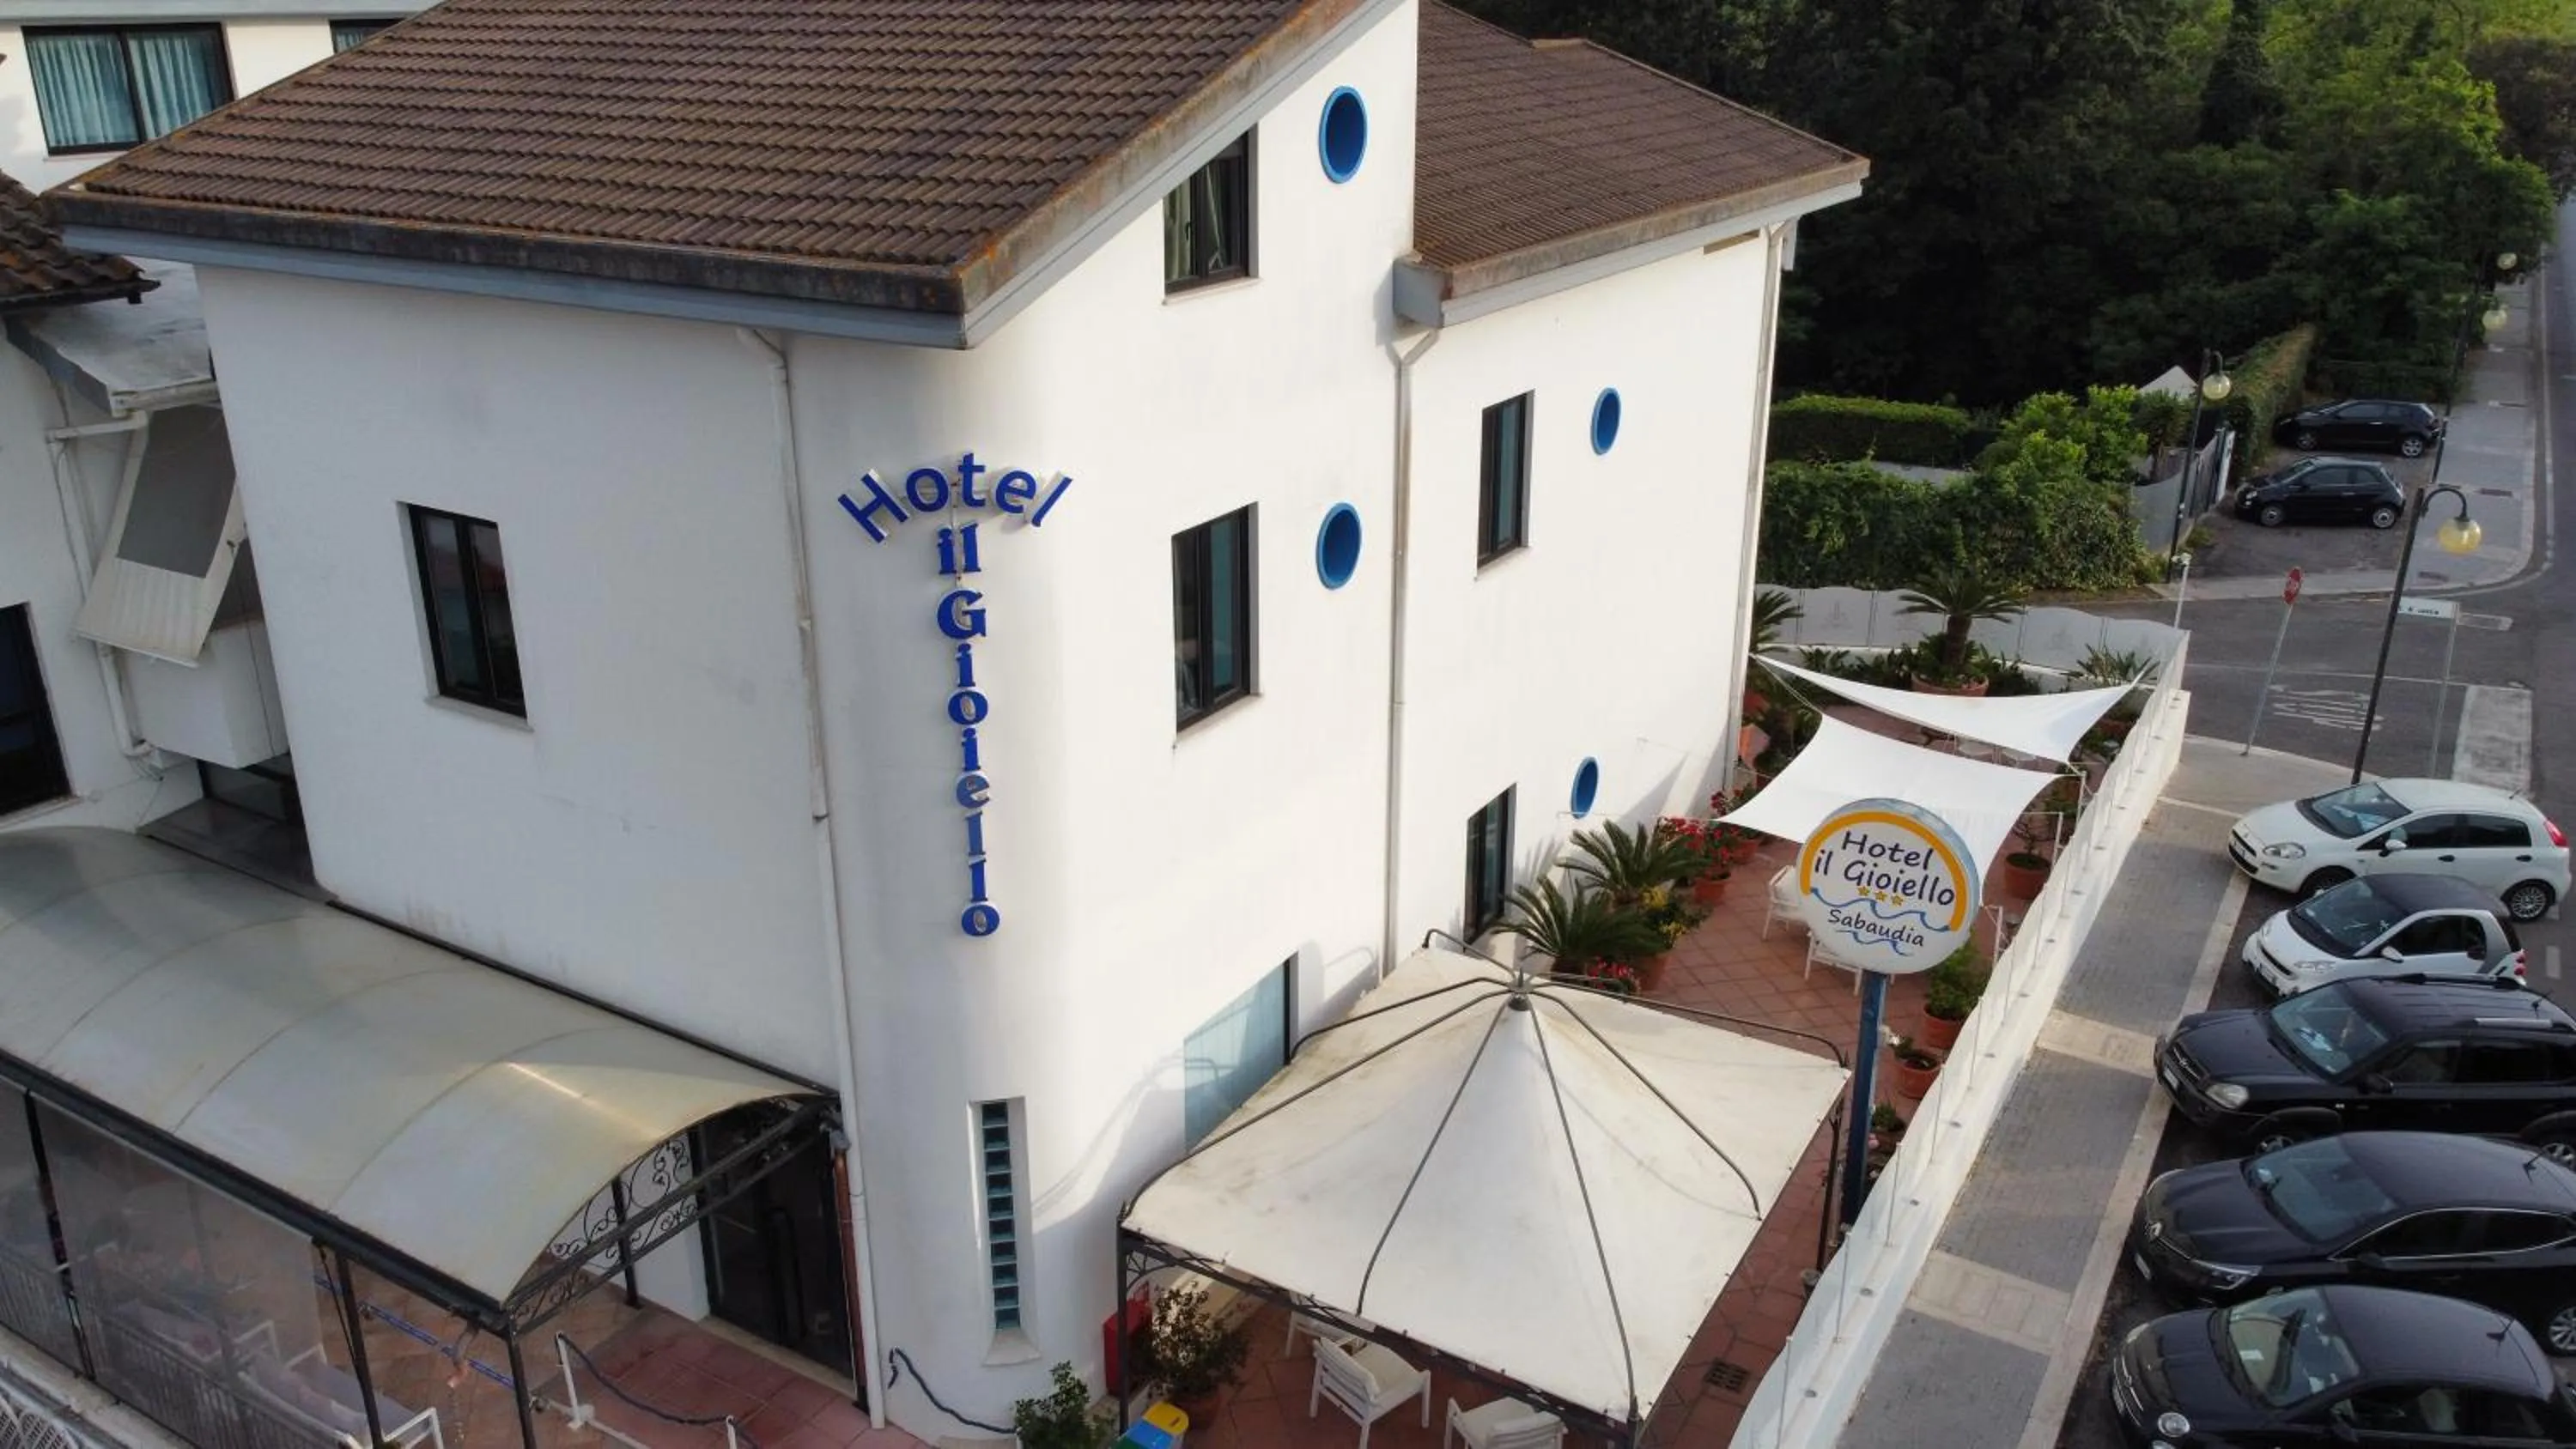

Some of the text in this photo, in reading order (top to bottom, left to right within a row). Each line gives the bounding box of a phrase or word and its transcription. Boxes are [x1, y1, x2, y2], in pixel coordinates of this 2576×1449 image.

[837, 452, 1073, 543] Hotel
[937, 523, 981, 575] il
[936, 590, 1000, 937] Gioiello
[1841, 830, 1935, 870] Hotel
[1814, 849, 1955, 906] il Gioiello
[1828, 909, 1925, 947] Sabaudia
